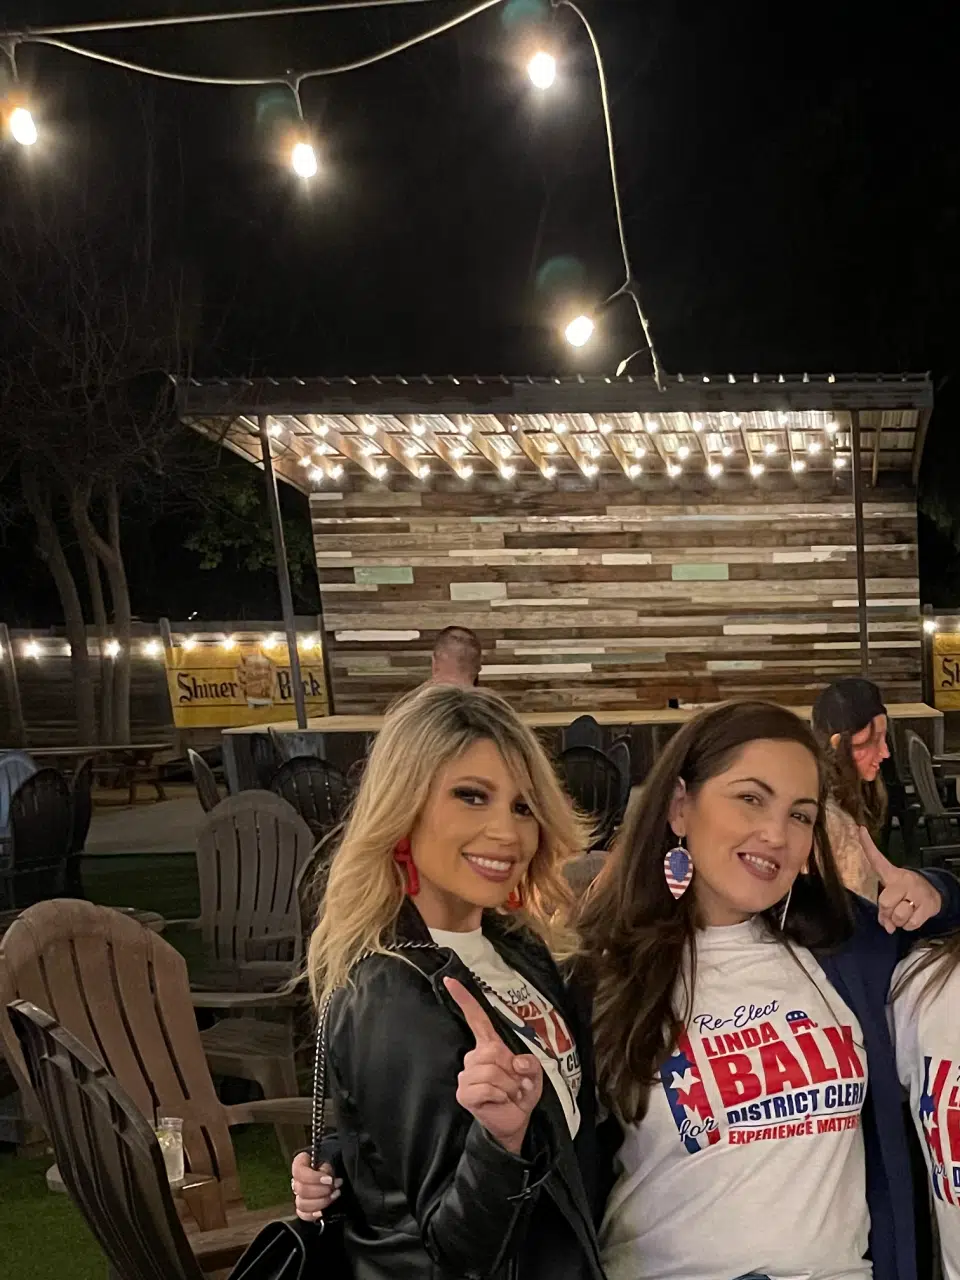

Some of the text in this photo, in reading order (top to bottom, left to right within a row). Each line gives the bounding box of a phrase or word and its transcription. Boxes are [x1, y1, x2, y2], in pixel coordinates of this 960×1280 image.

[177, 670, 323, 703] Shiner Bck
[693, 1000, 780, 1034] Re-Elect
[701, 1022, 780, 1058] LINDA
[709, 1025, 865, 1109] BALK
[727, 1089, 820, 1125] DISTRICT
[679, 1117, 719, 1142] for
[727, 1121, 814, 1146] EXPERIENCE
